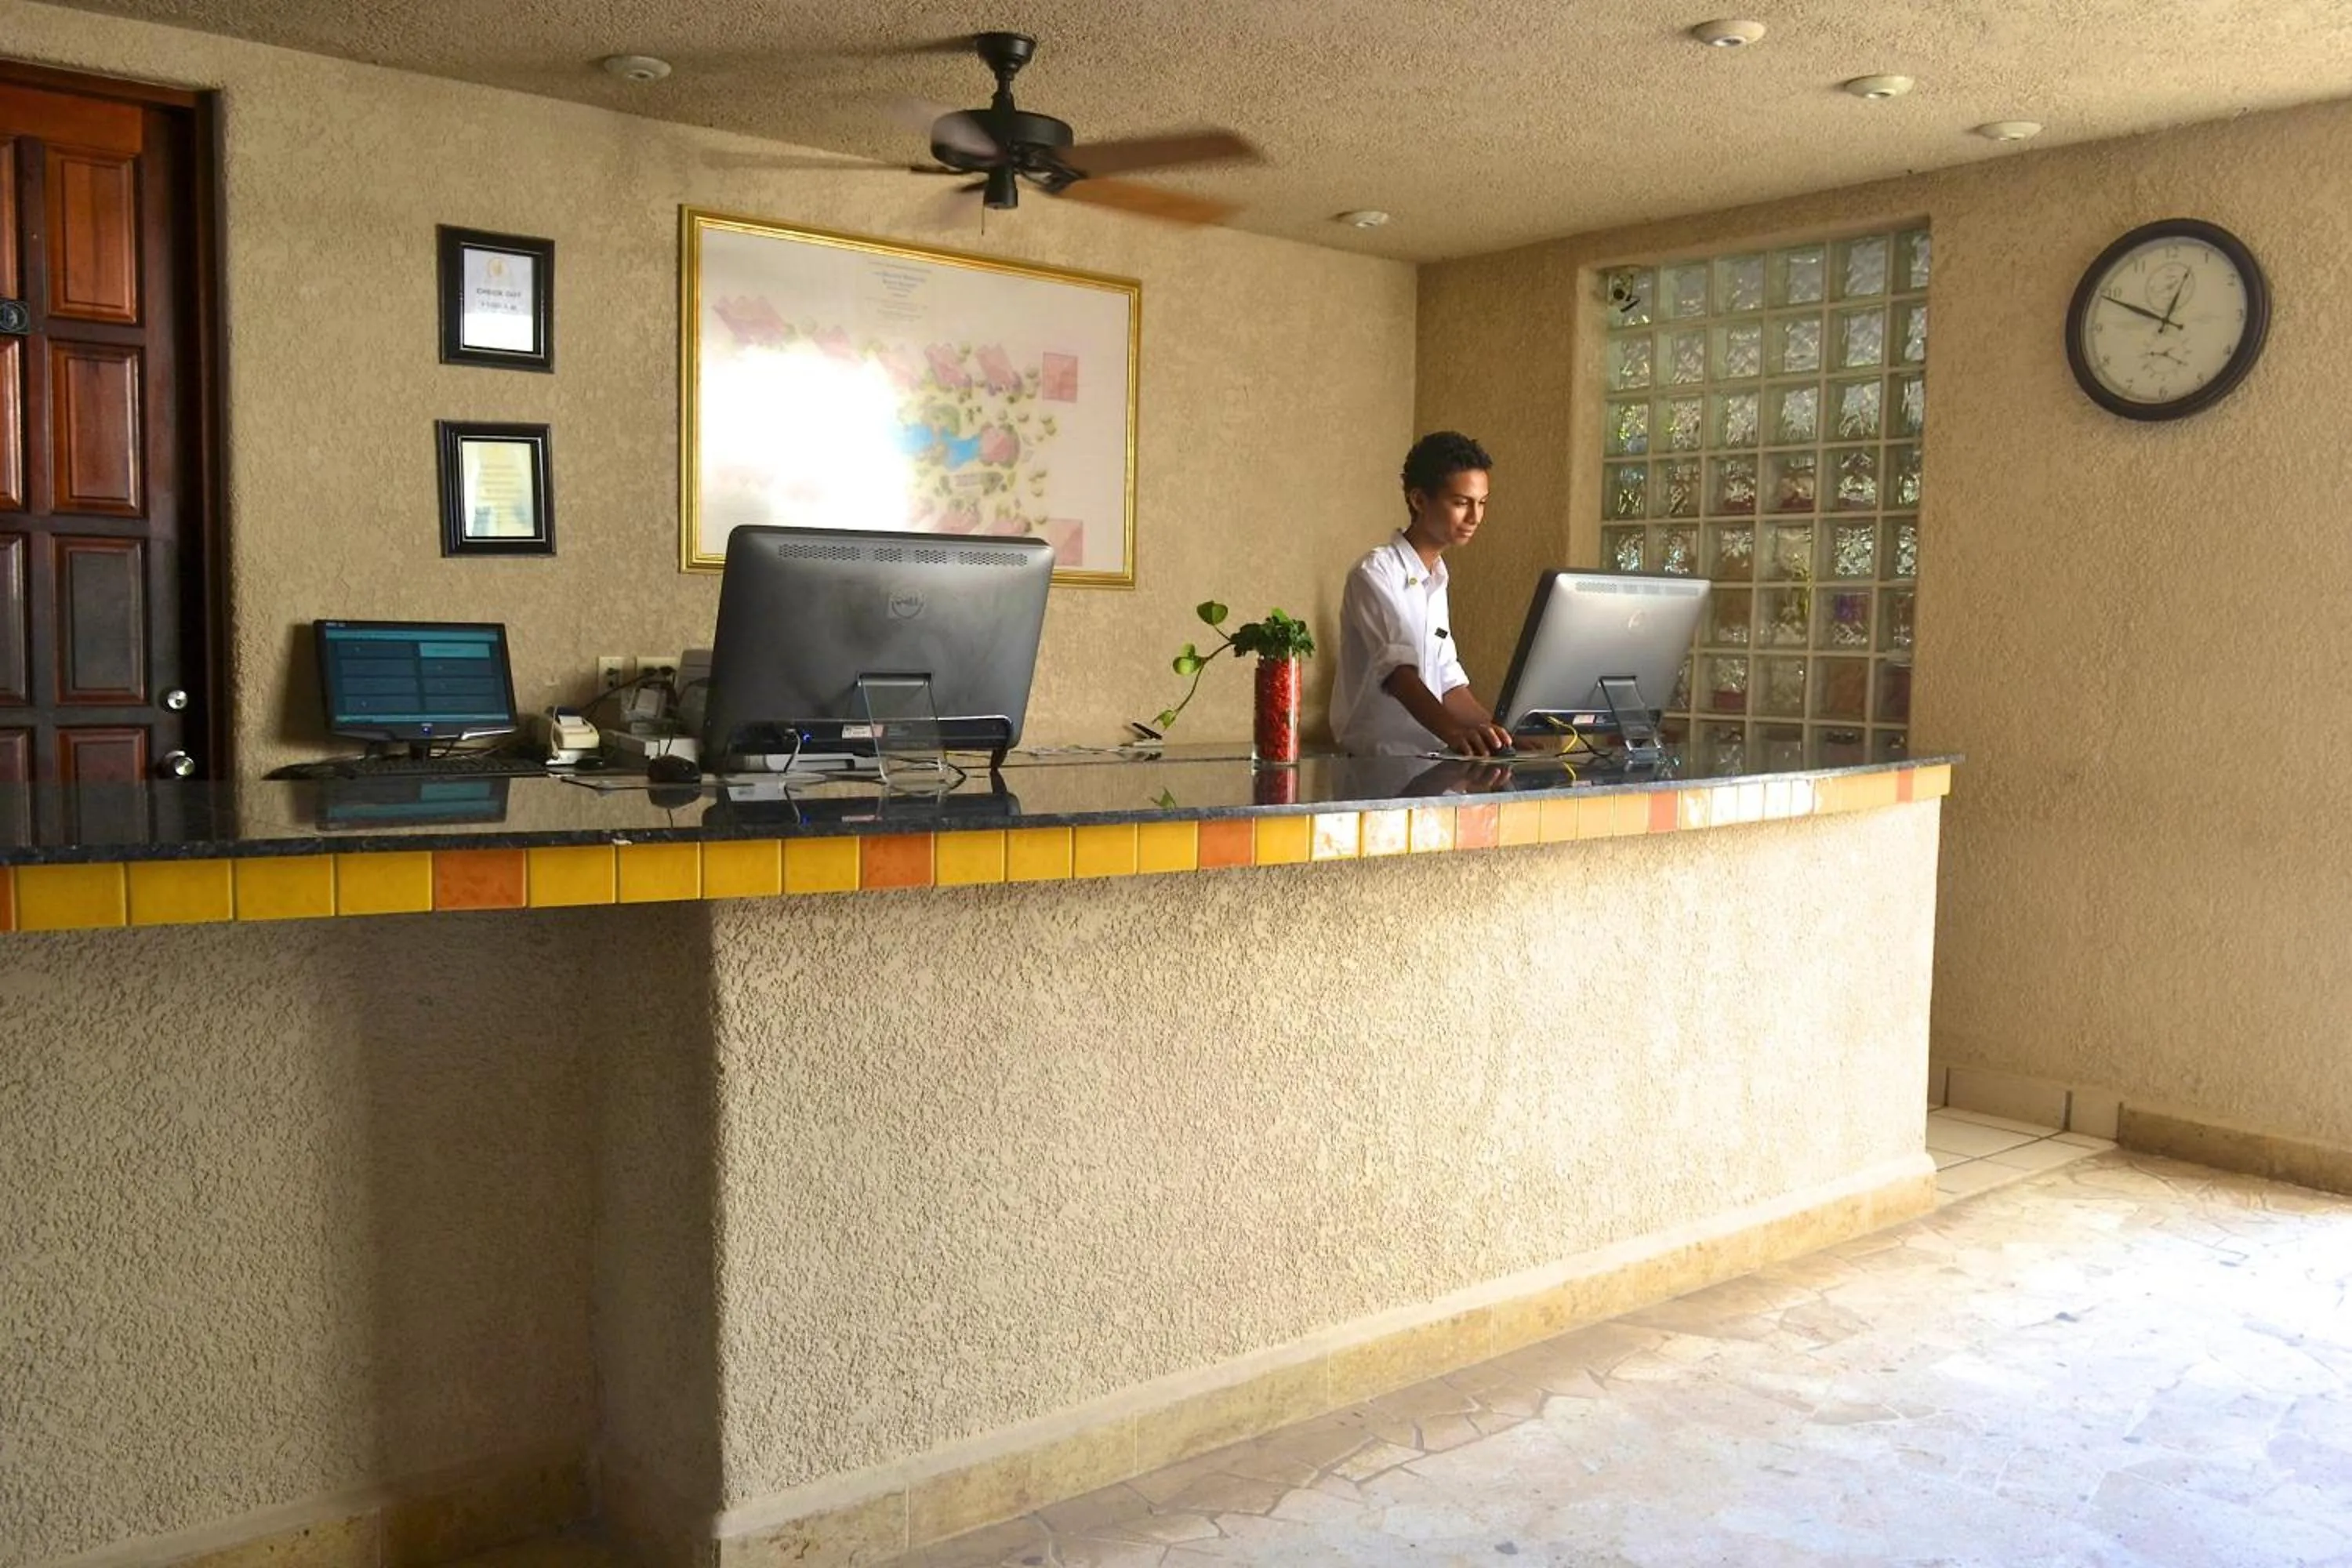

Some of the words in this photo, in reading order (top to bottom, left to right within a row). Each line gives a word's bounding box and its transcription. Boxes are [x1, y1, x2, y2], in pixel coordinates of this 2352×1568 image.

[2165, 245, 2179, 260] 12
[2133, 260, 2146, 273] 11
[2227, 272, 2237, 287] 2
[2107, 286, 2123, 299] 10
[2236, 308, 2244, 321] 3
[2094, 322, 2103, 334] 9
[2223, 345, 2232, 356] 4
[2100, 355, 2110, 366] 8
[2125, 377, 2134, 390] 7
[2196, 372, 2204, 386] 5
[2158, 385, 2169, 401] 6
